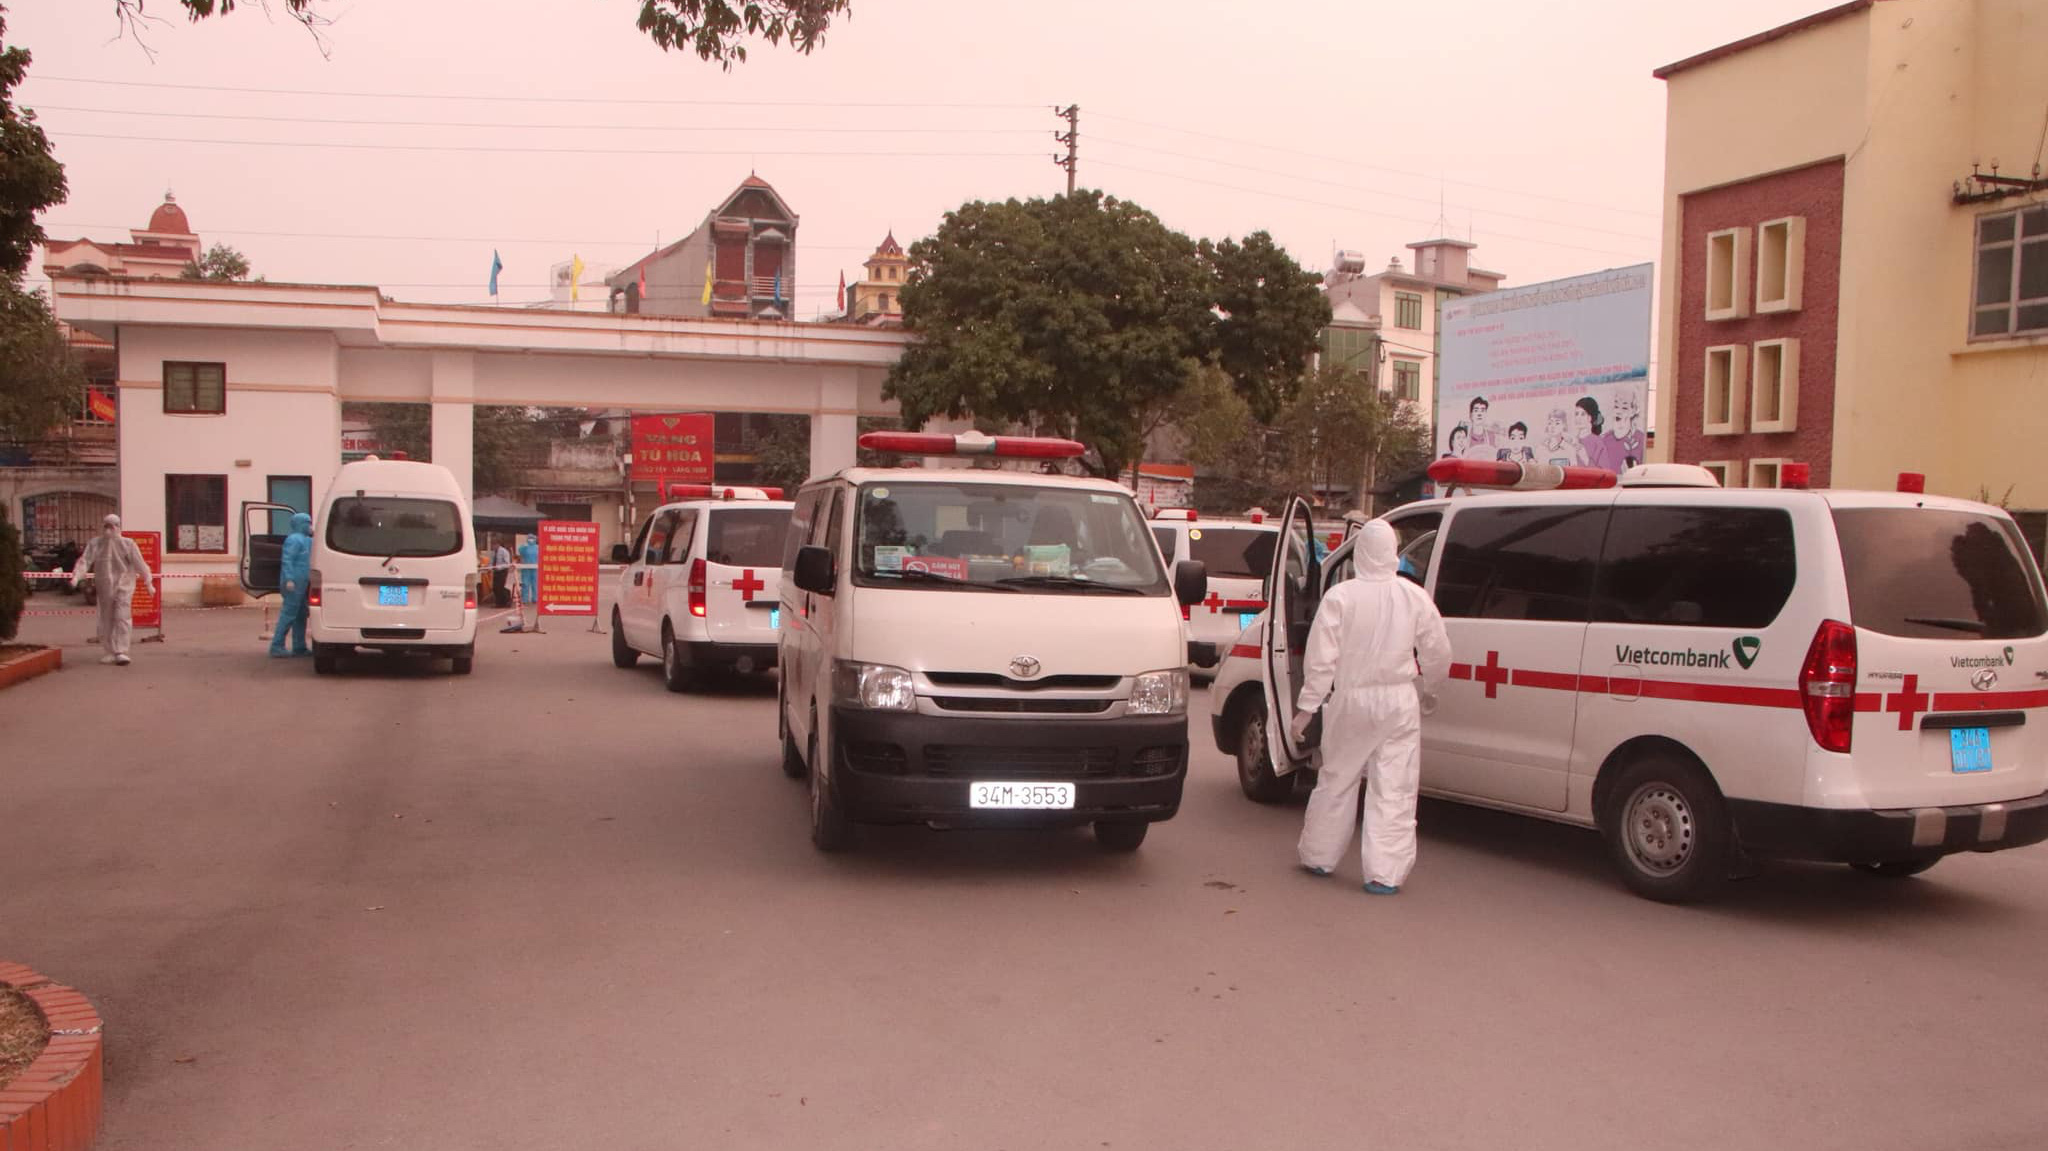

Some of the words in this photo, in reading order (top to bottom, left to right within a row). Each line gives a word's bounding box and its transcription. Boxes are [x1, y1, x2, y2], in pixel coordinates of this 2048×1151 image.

[1616, 644, 1731, 669] Vietcombank
[1950, 655, 2005, 668] Vietcombank
[977, 785, 1069, 806] 34M-3553
